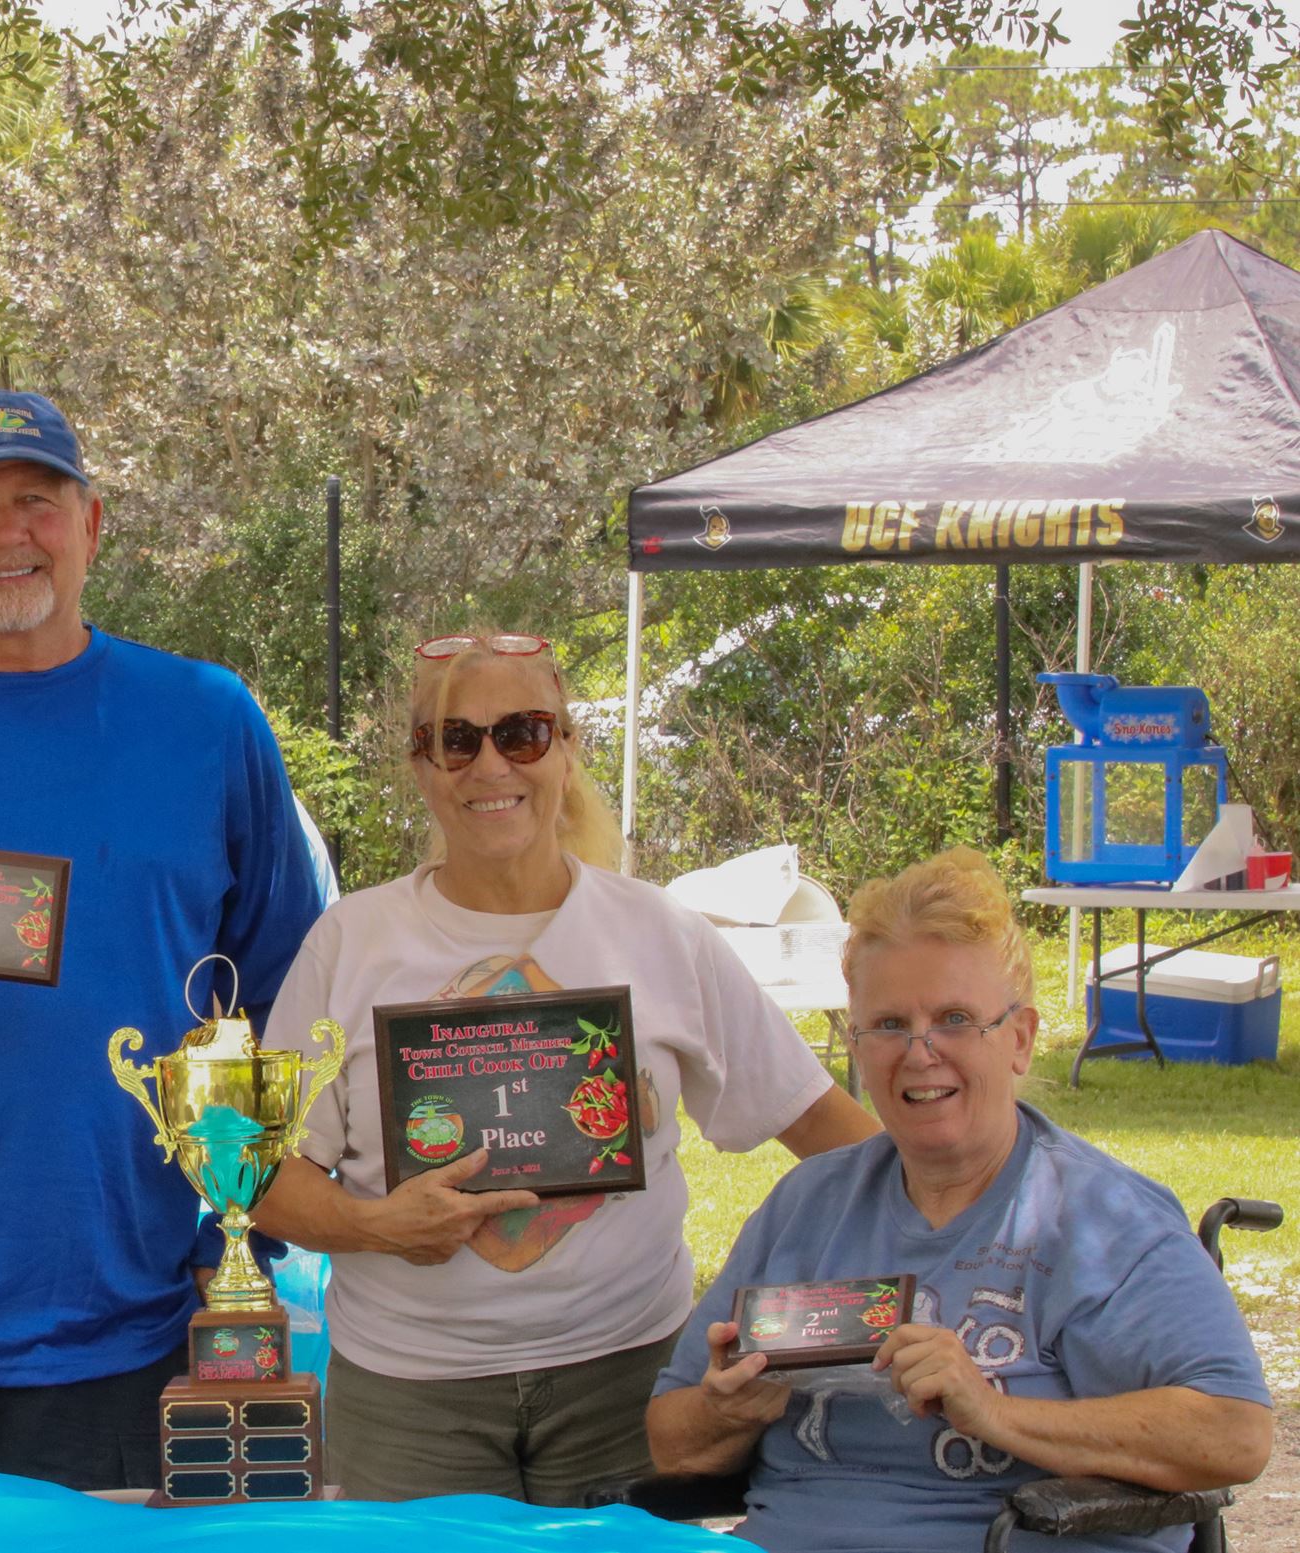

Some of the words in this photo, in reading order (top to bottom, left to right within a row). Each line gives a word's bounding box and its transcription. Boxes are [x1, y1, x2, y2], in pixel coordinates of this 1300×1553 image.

[841, 500, 928, 551] UCF
[935, 498, 1126, 549] KNIGHTS
[430, 1020, 539, 1042] INAUGURAL
[399, 1047, 443, 1062] TOWN
[446, 1043, 509, 1058] COUNCIL
[510, 1036, 573, 1052] MEMBER
[408, 1062, 465, 1081] CHILI
[468, 1057, 525, 1076] COOK
[529, 1052, 569, 1071] OFF
[492, 1076, 530, 1119] 1st
[480, 1128, 548, 1151] Place
[805, 1307, 839, 1328] 2nd
[802, 1327, 840, 1337] Place
